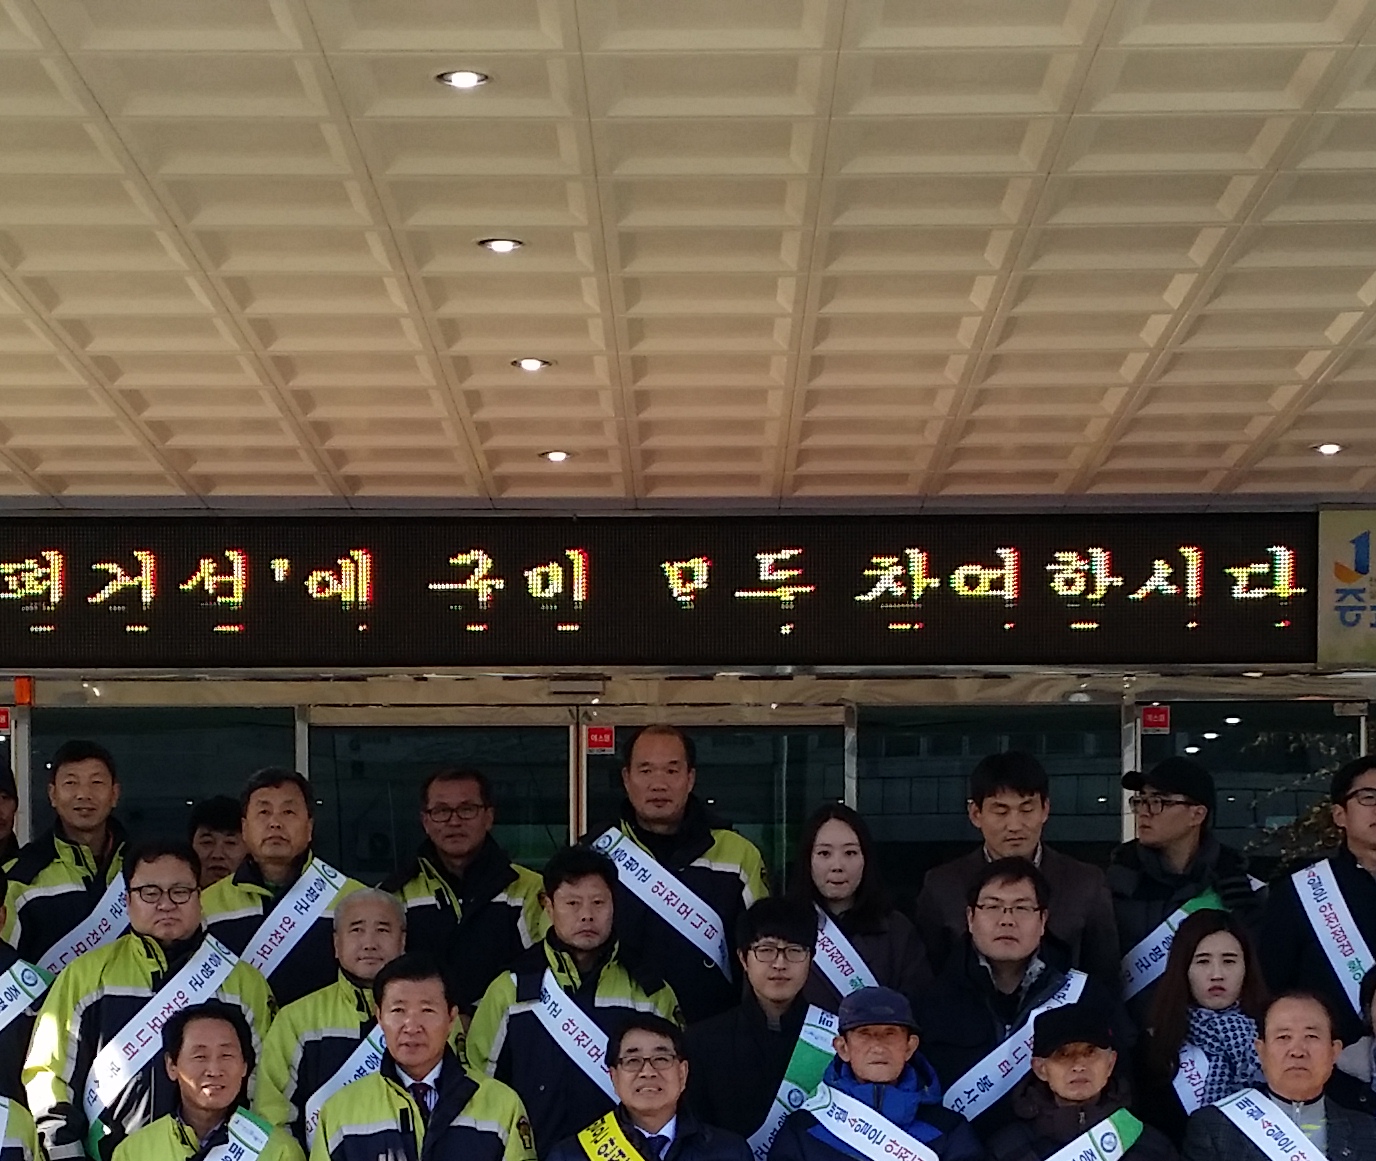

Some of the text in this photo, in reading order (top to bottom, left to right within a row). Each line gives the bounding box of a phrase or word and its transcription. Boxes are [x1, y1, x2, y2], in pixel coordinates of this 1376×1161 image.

[293, 876, 327, 914] 증평군
[611, 846, 718, 939] 증평군 안전모니터
[1318, 902, 1354, 958] 안전점검
[187, 952, 222, 991] 증평군
[1236, 1096, 1265, 1122] 매월
[1258, 1117, 1296, 1153] 4일은
